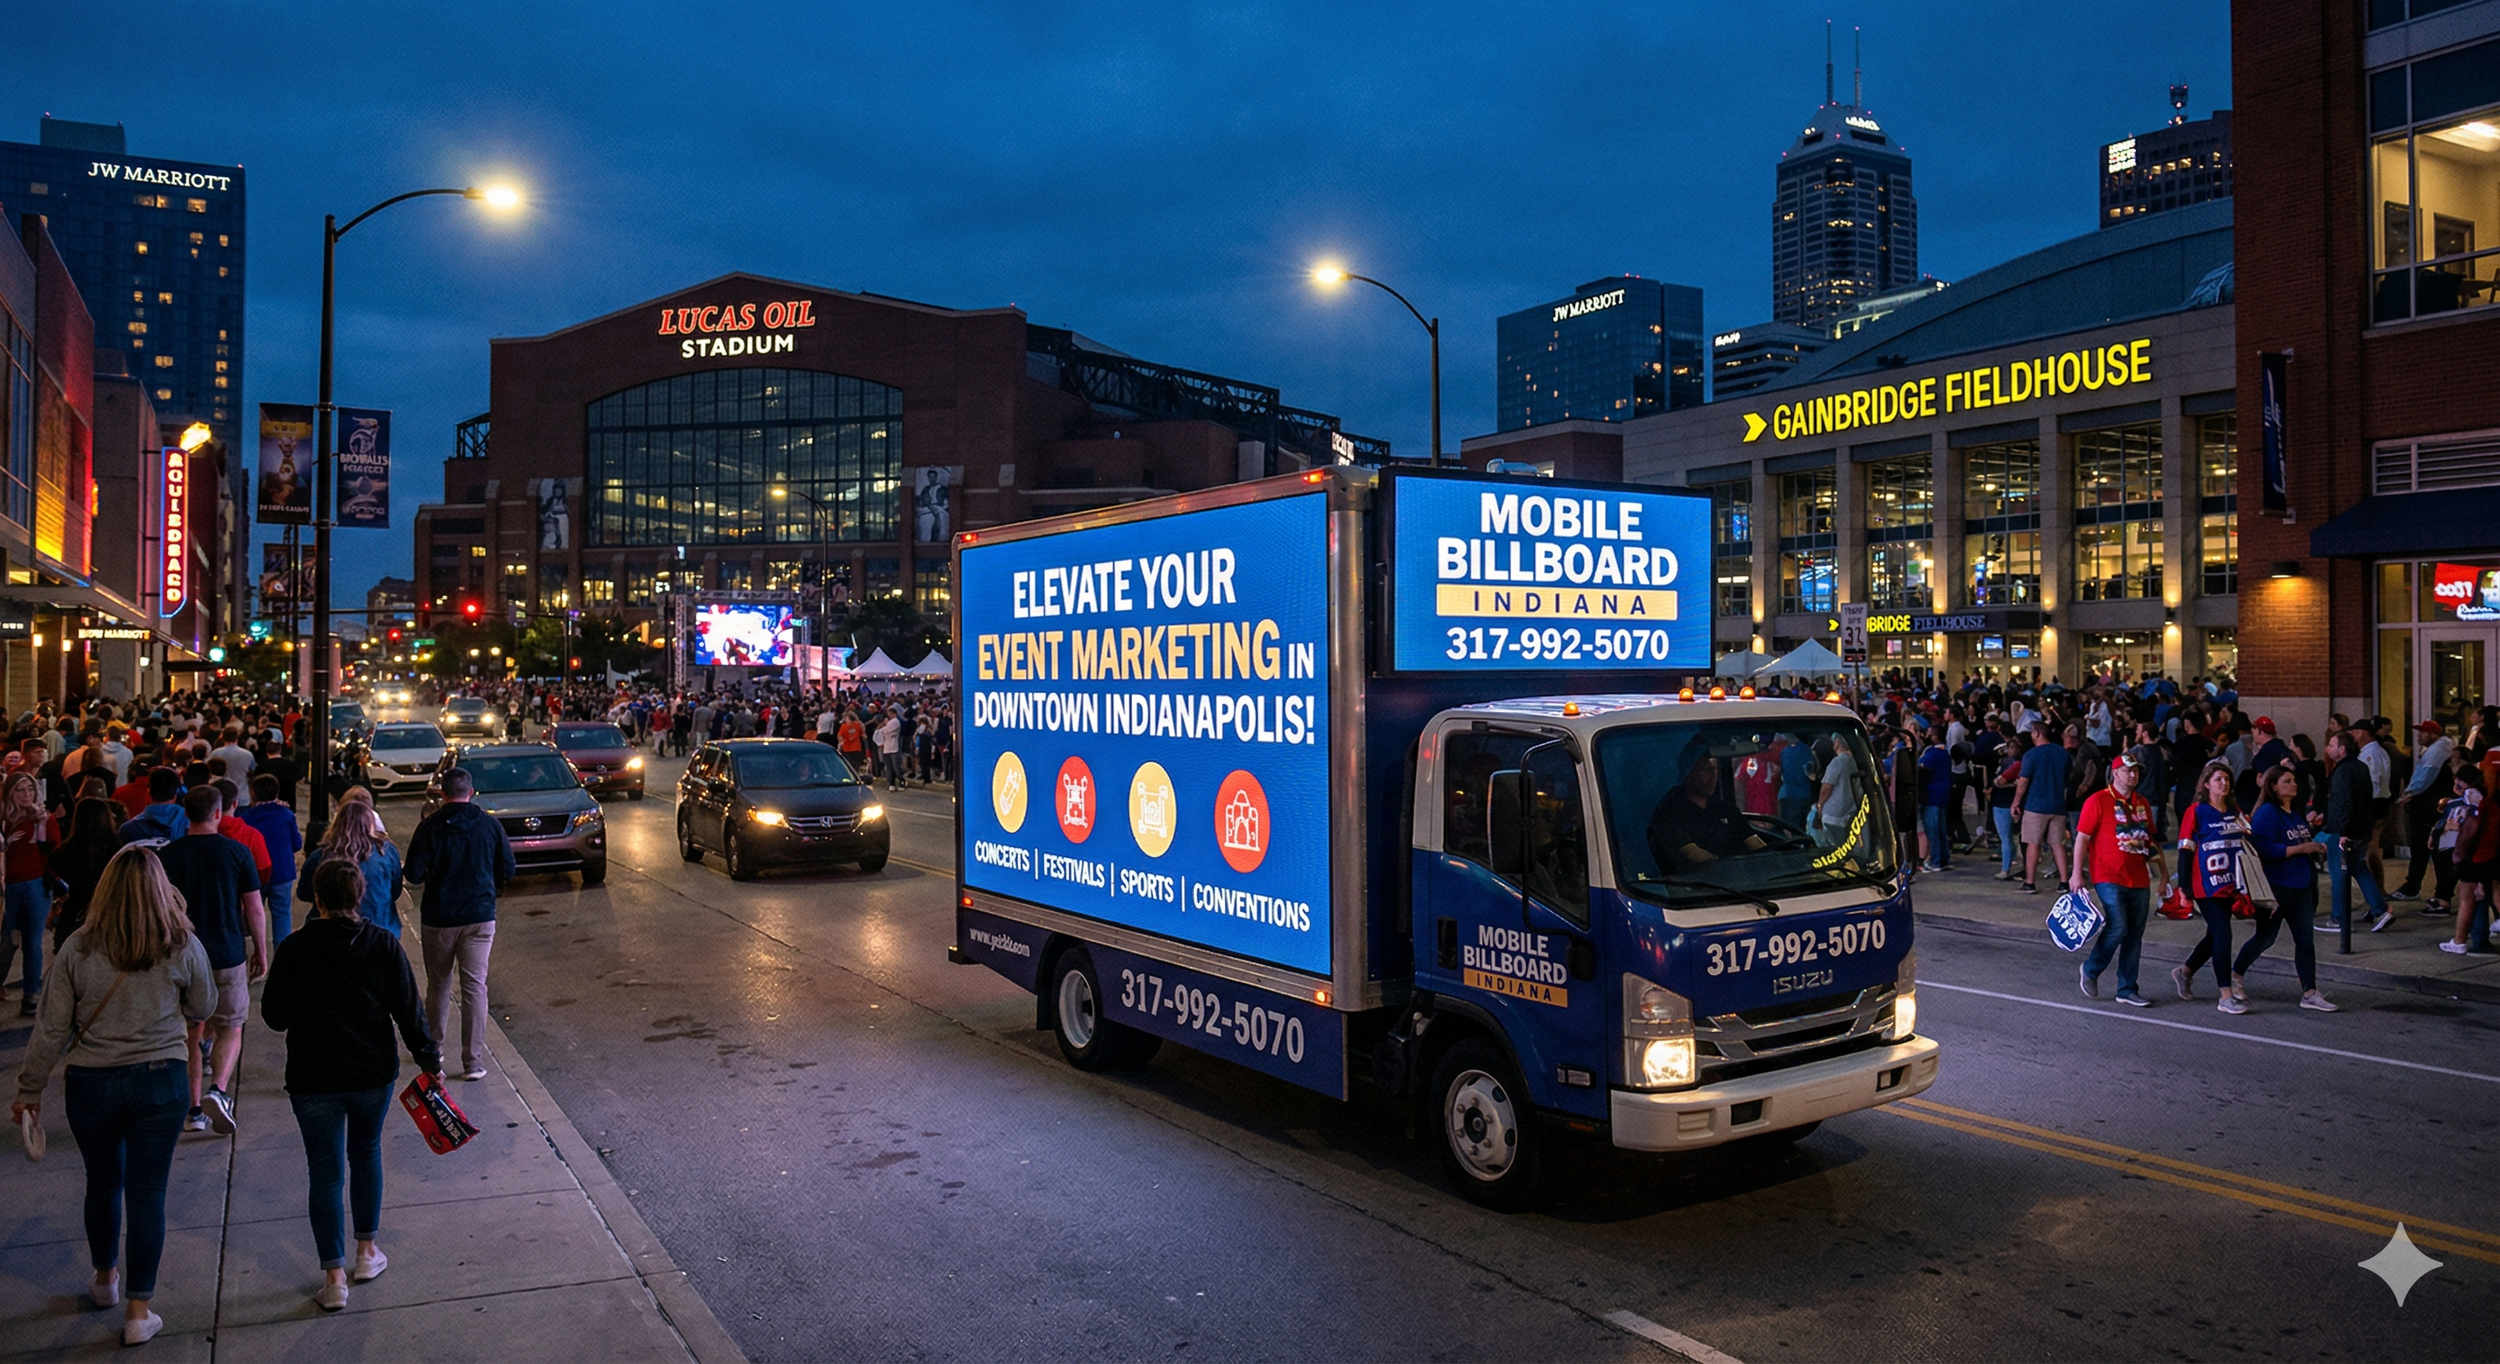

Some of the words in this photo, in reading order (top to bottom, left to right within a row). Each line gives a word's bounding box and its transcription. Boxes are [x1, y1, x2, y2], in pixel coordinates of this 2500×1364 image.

[88, 162, 120, 179] JW
[123, 165, 231, 191] MARRIOTT
[658, 303, 756, 335] LUCAS
[763, 301, 816, 329] OIL
[1552, 307, 1569, 323] JW
[1569, 289, 1626, 318] MARRIOTT
[681, 334, 794, 359] STADIUM
[1772, 377, 1938, 440] GAINBRIDGE
[1945, 338, 2152, 413] FIELDHOUSE
[1481, 492, 1643, 541] MOBILE
[1437, 536, 1679, 586] BILLBOARD
[1013, 558, 1133, 619] ELEVATE
[1139, 548, 1237, 610] YOUR
[1474, 591, 1646, 615] INDIANA
[978, 631, 1064, 681] EVENT
[1072, 618, 1281, 681] MARKETING
[1288, 642, 1314, 679] IN
[1445, 626, 1670, 661] 317-992-5070
[974, 691, 1099, 734] DOWNTOWN
[1105, 693, 1315, 745] INDIANAPOLIS!
[974, 840, 1030, 872] CONCERTS
[1043, 853, 1105, 889] FESTIVALS
[1120, 868, 1175, 903] SPORTS
[1193, 882, 1311, 932] CONVENTIONS
[1478, 924, 1549, 958] MOBILE
[1706, 919, 1886, 977] 317-992-5070
[1463, 944, 1567, 985] BILLBOARD
[1773, 969, 1834, 995] ISUZU
[1476, 972, 1552, 1002] INDIANA
[1120, 968, 1305, 1063] 317-992-5070
